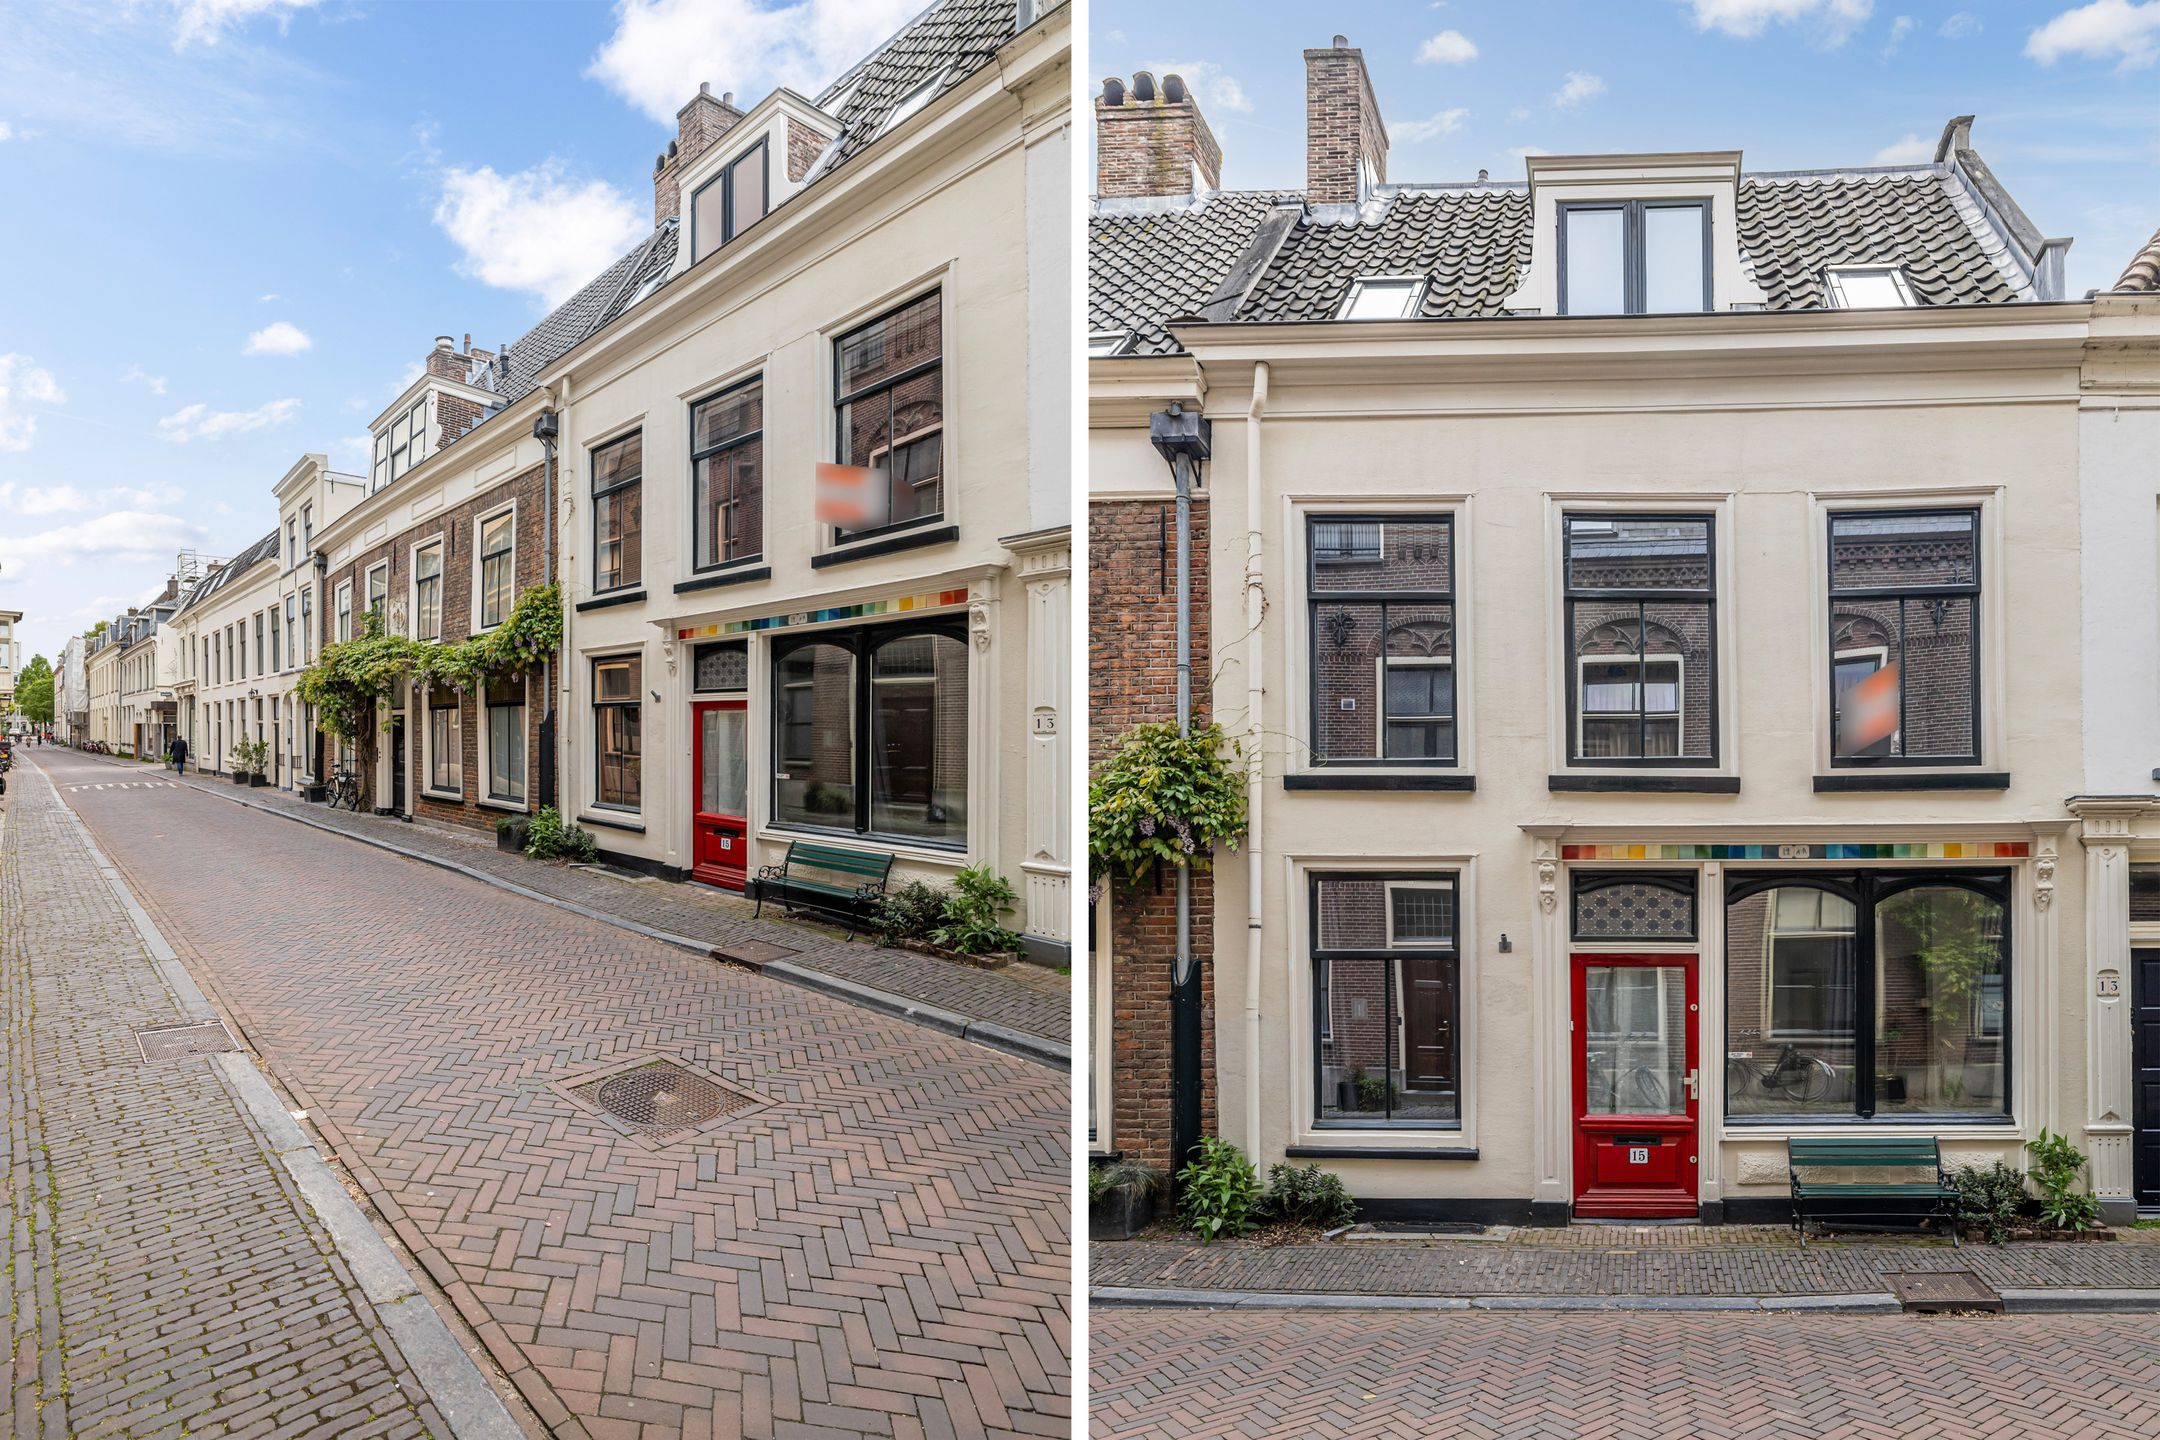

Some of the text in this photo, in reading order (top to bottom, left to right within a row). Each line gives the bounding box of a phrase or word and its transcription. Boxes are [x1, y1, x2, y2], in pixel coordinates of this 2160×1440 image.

[1037, 718, 1055, 729] 13
[2100, 980, 2118, 991] 13
[1632, 1150, 1646, 1162] 15
